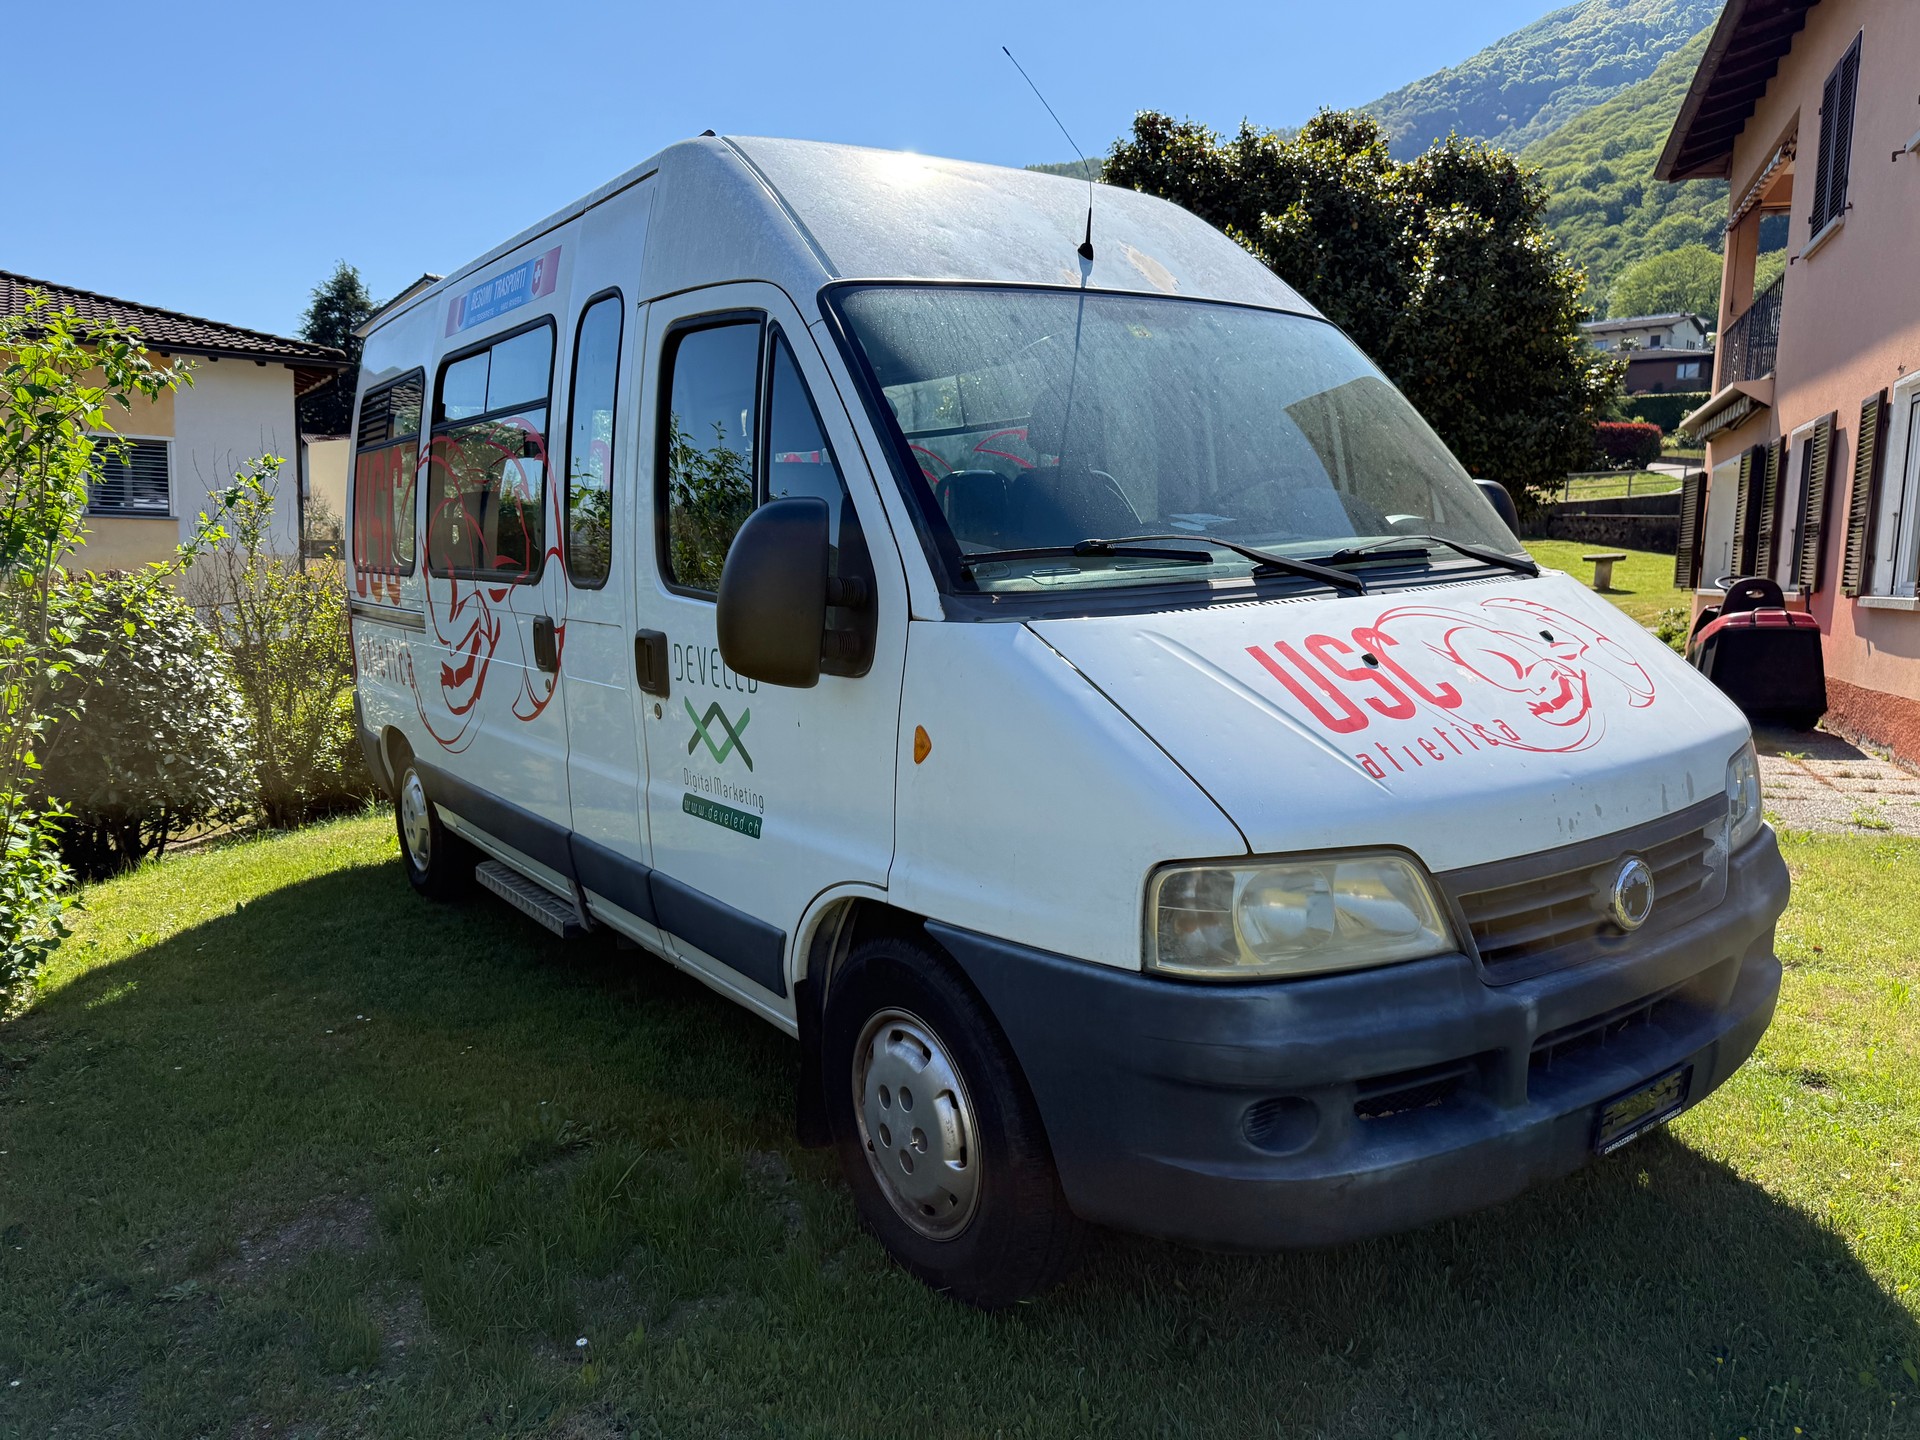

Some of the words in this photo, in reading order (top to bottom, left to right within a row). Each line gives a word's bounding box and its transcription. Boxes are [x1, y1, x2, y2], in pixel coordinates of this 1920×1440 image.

[354, 446, 404, 605] USC
[1245, 627, 1463, 734] USC
[1355, 719, 1522, 780] atletica
[684, 799, 760, 838] www.develed.ch
